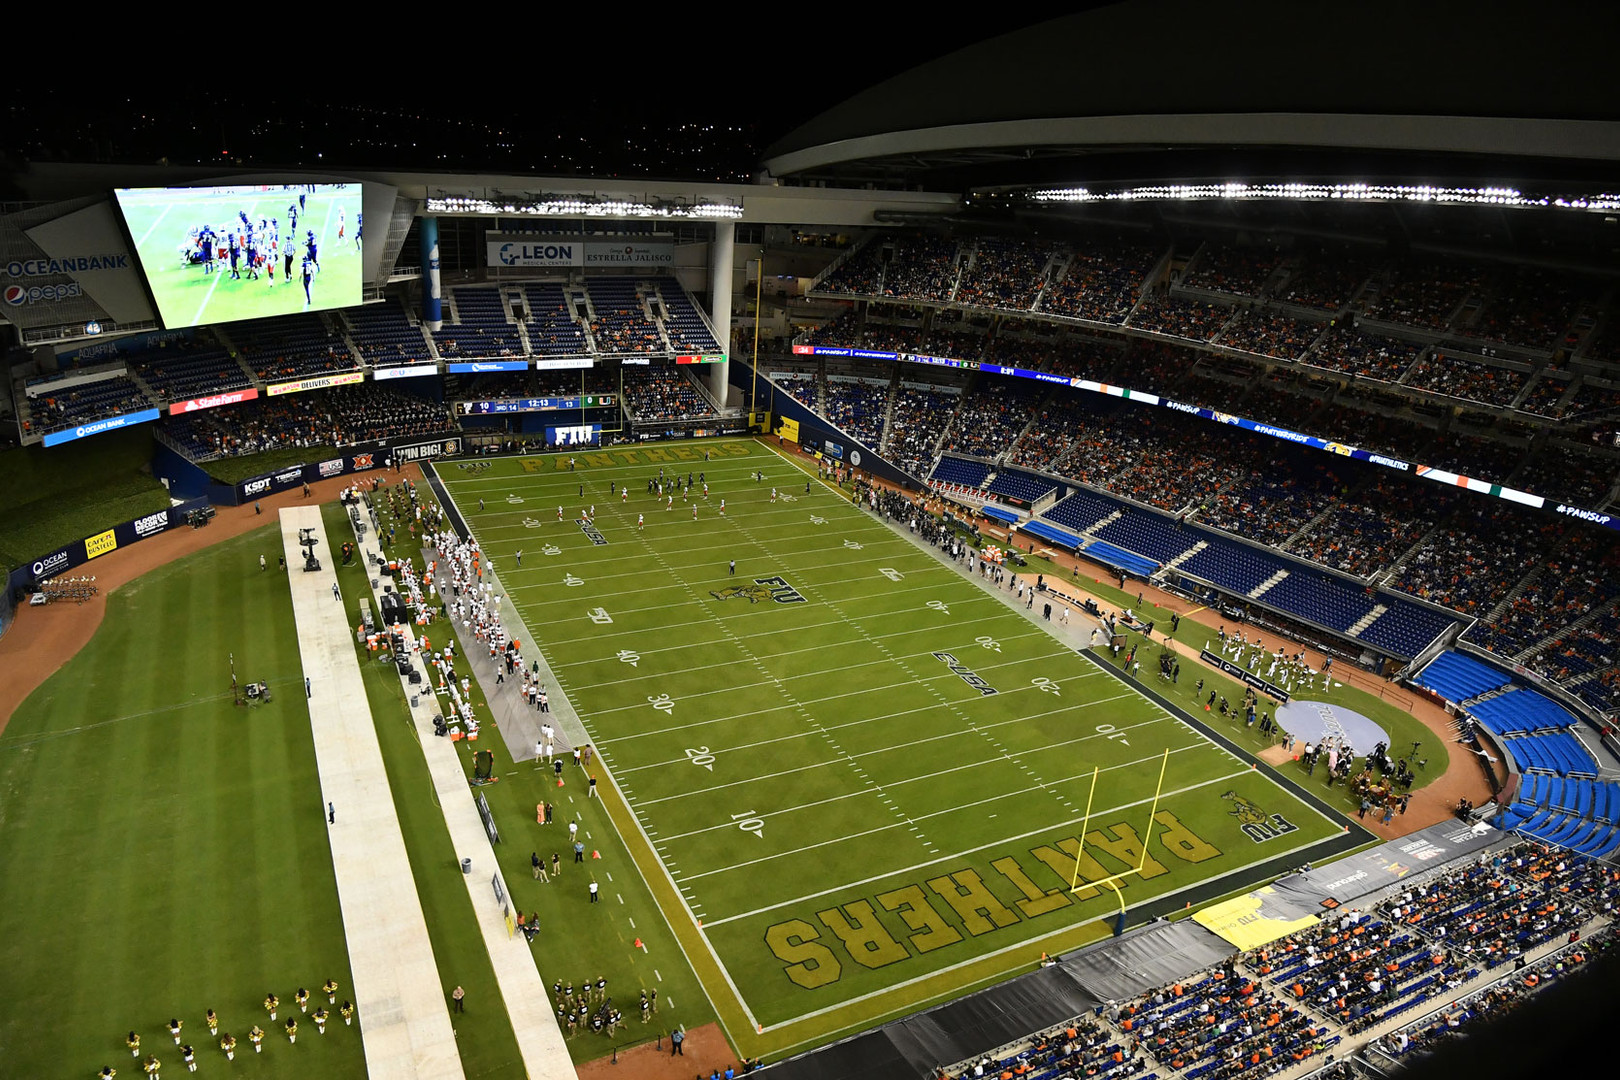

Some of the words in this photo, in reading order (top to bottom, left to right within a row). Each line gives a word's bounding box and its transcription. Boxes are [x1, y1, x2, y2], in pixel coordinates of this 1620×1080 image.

[522, 246, 572, 259] LEON
[28, 280, 81, 304] pepsi
[301, 379, 331, 389] DELIVERS
[528, 399, 549, 407] 12:13
[1166, 401, 1200, 414] #PAWSUP
[86, 422, 106, 434] OCEAN
[107, 418, 125, 428] BANK
[555, 426, 593, 446] FIU
[420, 444, 440, 457] BIG!
[518, 444, 751, 472] PANTHERS
[328, 462, 344, 470] USA
[244, 478, 271, 494] KSDT
[1556, 504, 1610, 524] #PAWSUP
[43, 551, 68, 566] OCEAN
[878, 568, 904, 582] 50
[753, 576, 808, 604] FIU
[587, 606, 614, 624] 50
[974, 636, 1001, 650] 30
[616, 650, 640, 663] 40
[1031, 676, 1061, 692] 20
[648, 693, 675, 710] 30
[1095, 724, 1128, 740] 10
[684, 746, 716, 766] 20
[730, 810, 765, 832] 10
[1240, 813, 1300, 844] FIU
[1326, 870, 1368, 891] getaround
[764, 808, 1224, 990] PANTHERS
